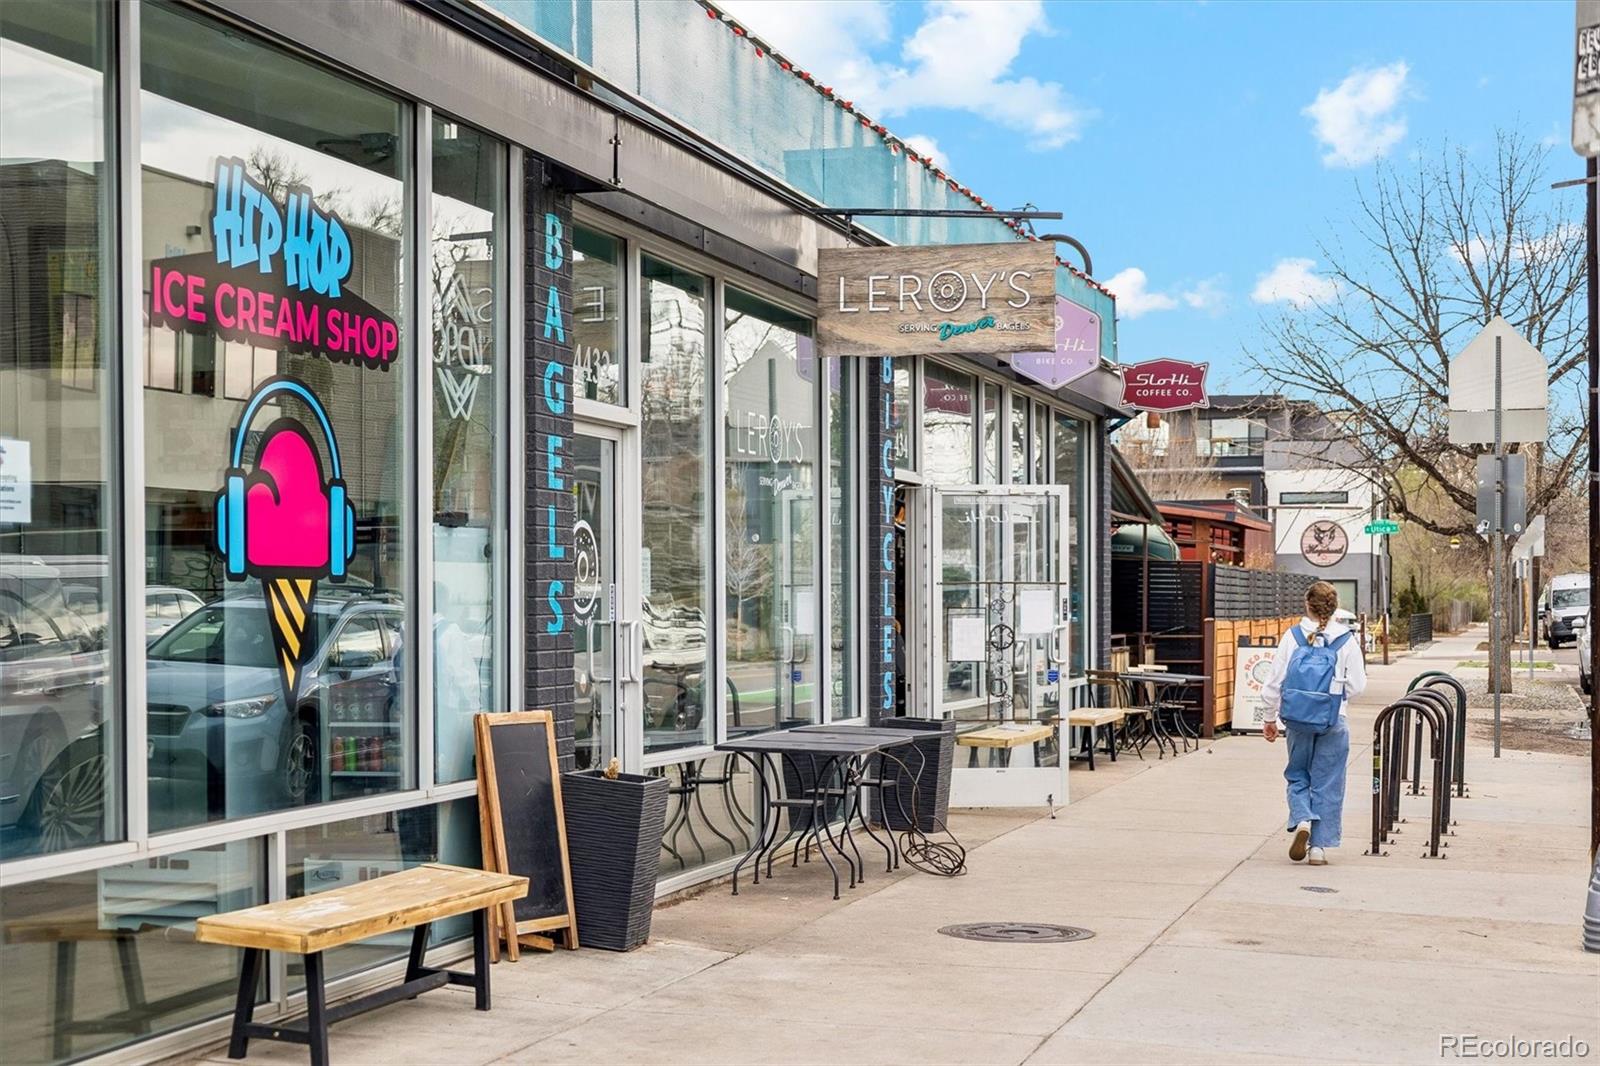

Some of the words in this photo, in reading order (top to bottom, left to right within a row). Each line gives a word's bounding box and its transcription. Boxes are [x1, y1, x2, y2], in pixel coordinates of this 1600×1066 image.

[213, 164, 282, 273] HIP
[284, 193, 351, 298] HOP
[153, 267, 207, 323] ICE
[215, 283, 320, 346] CREAM
[327, 309, 398, 361] SHOP
[839, 270, 1032, 313] LEROY'S
[899, 323, 938, 333] SERVING
[938, 315, 996, 341] Denver
[996, 321, 1031, 331] BAGELS
[1035, 357, 1056, 365] BIKE
[1136, 389, 1172, 397] COFFEE
[1176, 389, 1193, 397] CO.
[543, 213, 567, 636] BAGELS
[736, 409, 804, 464] LEROY'S
[883, 356, 895, 712] BICYCLES
